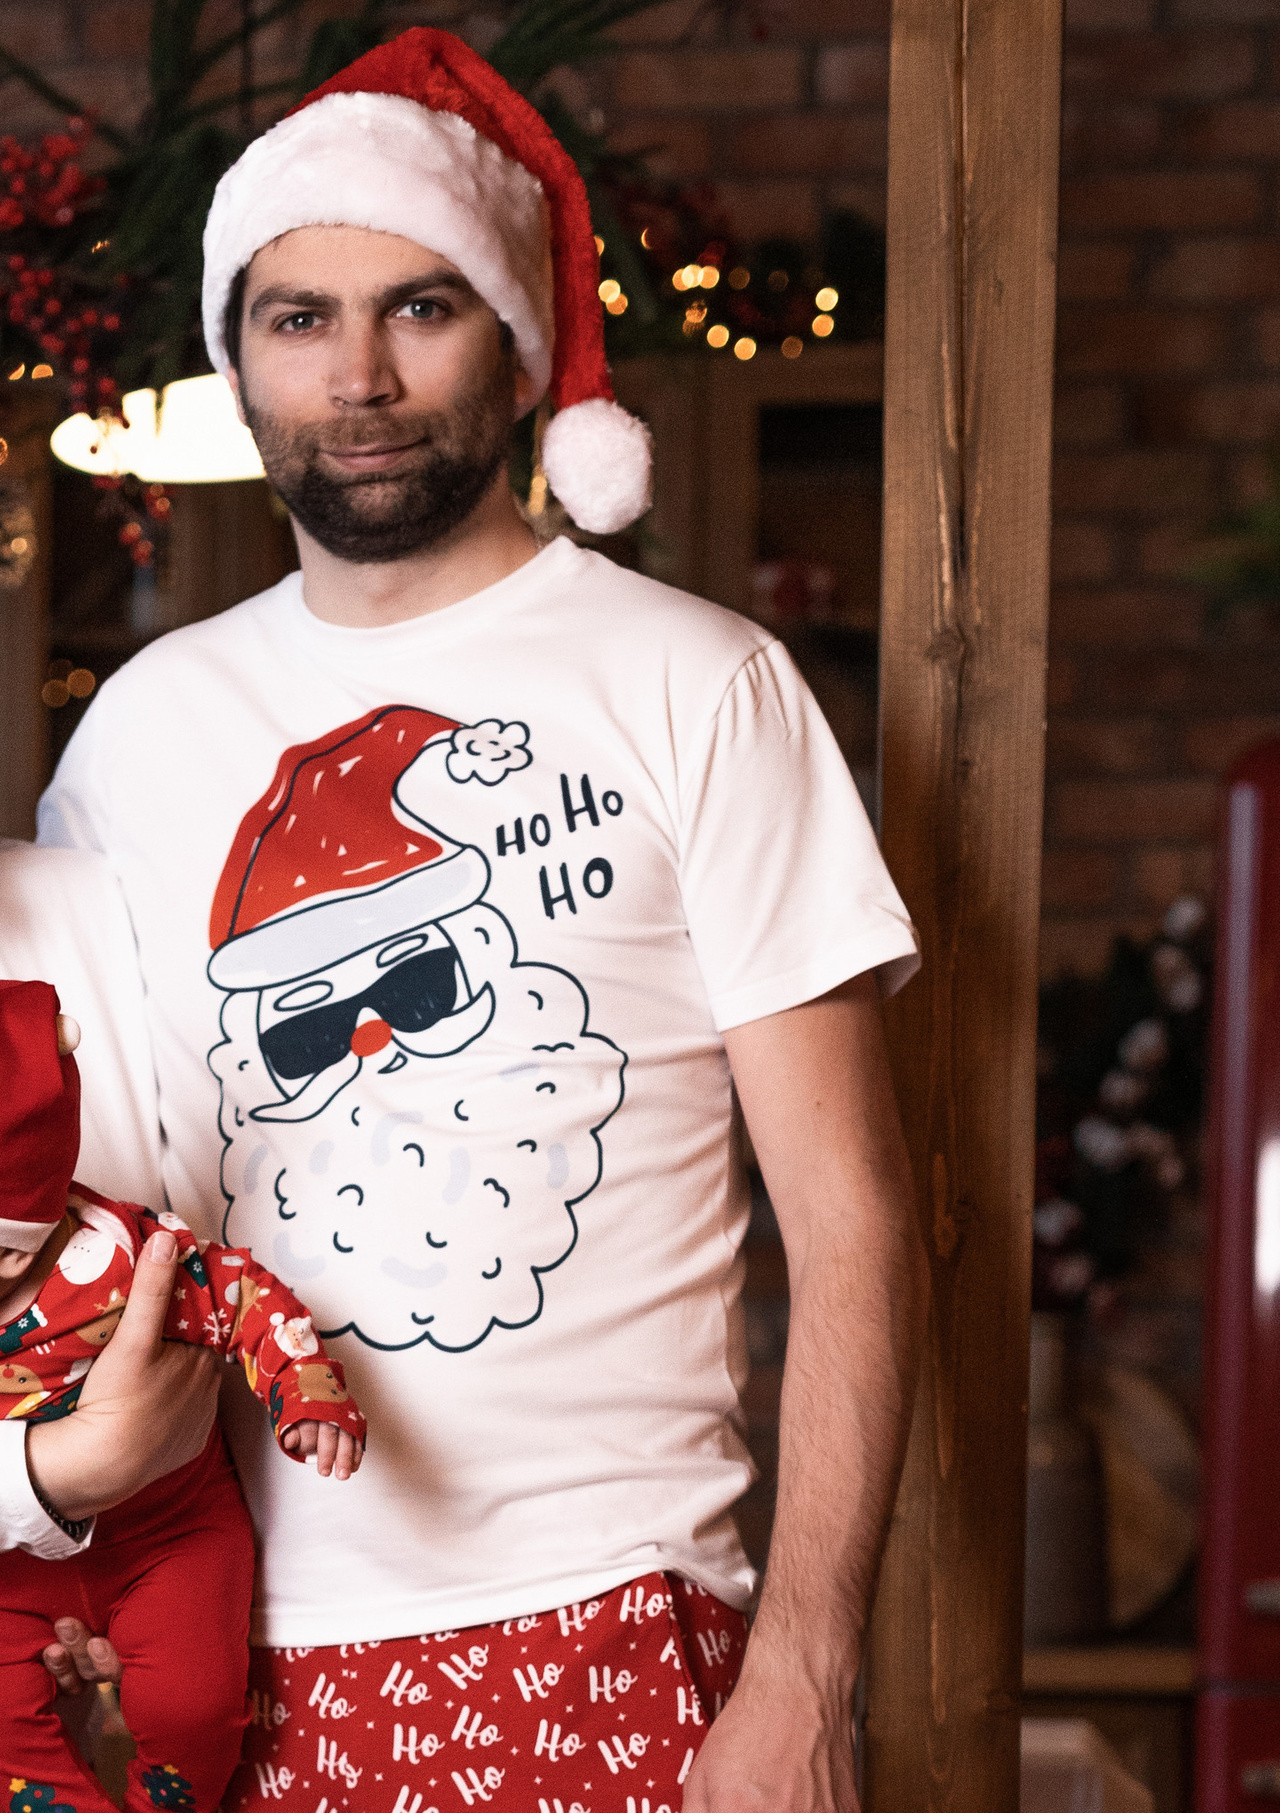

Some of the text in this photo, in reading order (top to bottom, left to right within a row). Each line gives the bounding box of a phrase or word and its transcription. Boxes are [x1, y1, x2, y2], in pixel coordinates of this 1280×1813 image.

[557, 1601, 604, 1637] Ho
[619, 1586, 667, 1624] Ho
[380, 1661, 431, 1707] Ho
[437, 1645, 489, 1690] Ho
[513, 1663, 564, 1702] Ho
[589, 1666, 637, 1703] Ho
[308, 1673, 356, 1719] Ho
[392, 1723, 444, 1764] Ho
[451, 1705, 502, 1749] Ho
[534, 1719, 585, 1762] Ho
[598, 1733, 650, 1774] Ho
[256, 1765, 295, 1799] Ho
[451, 1766, 505, 1805] Ho
